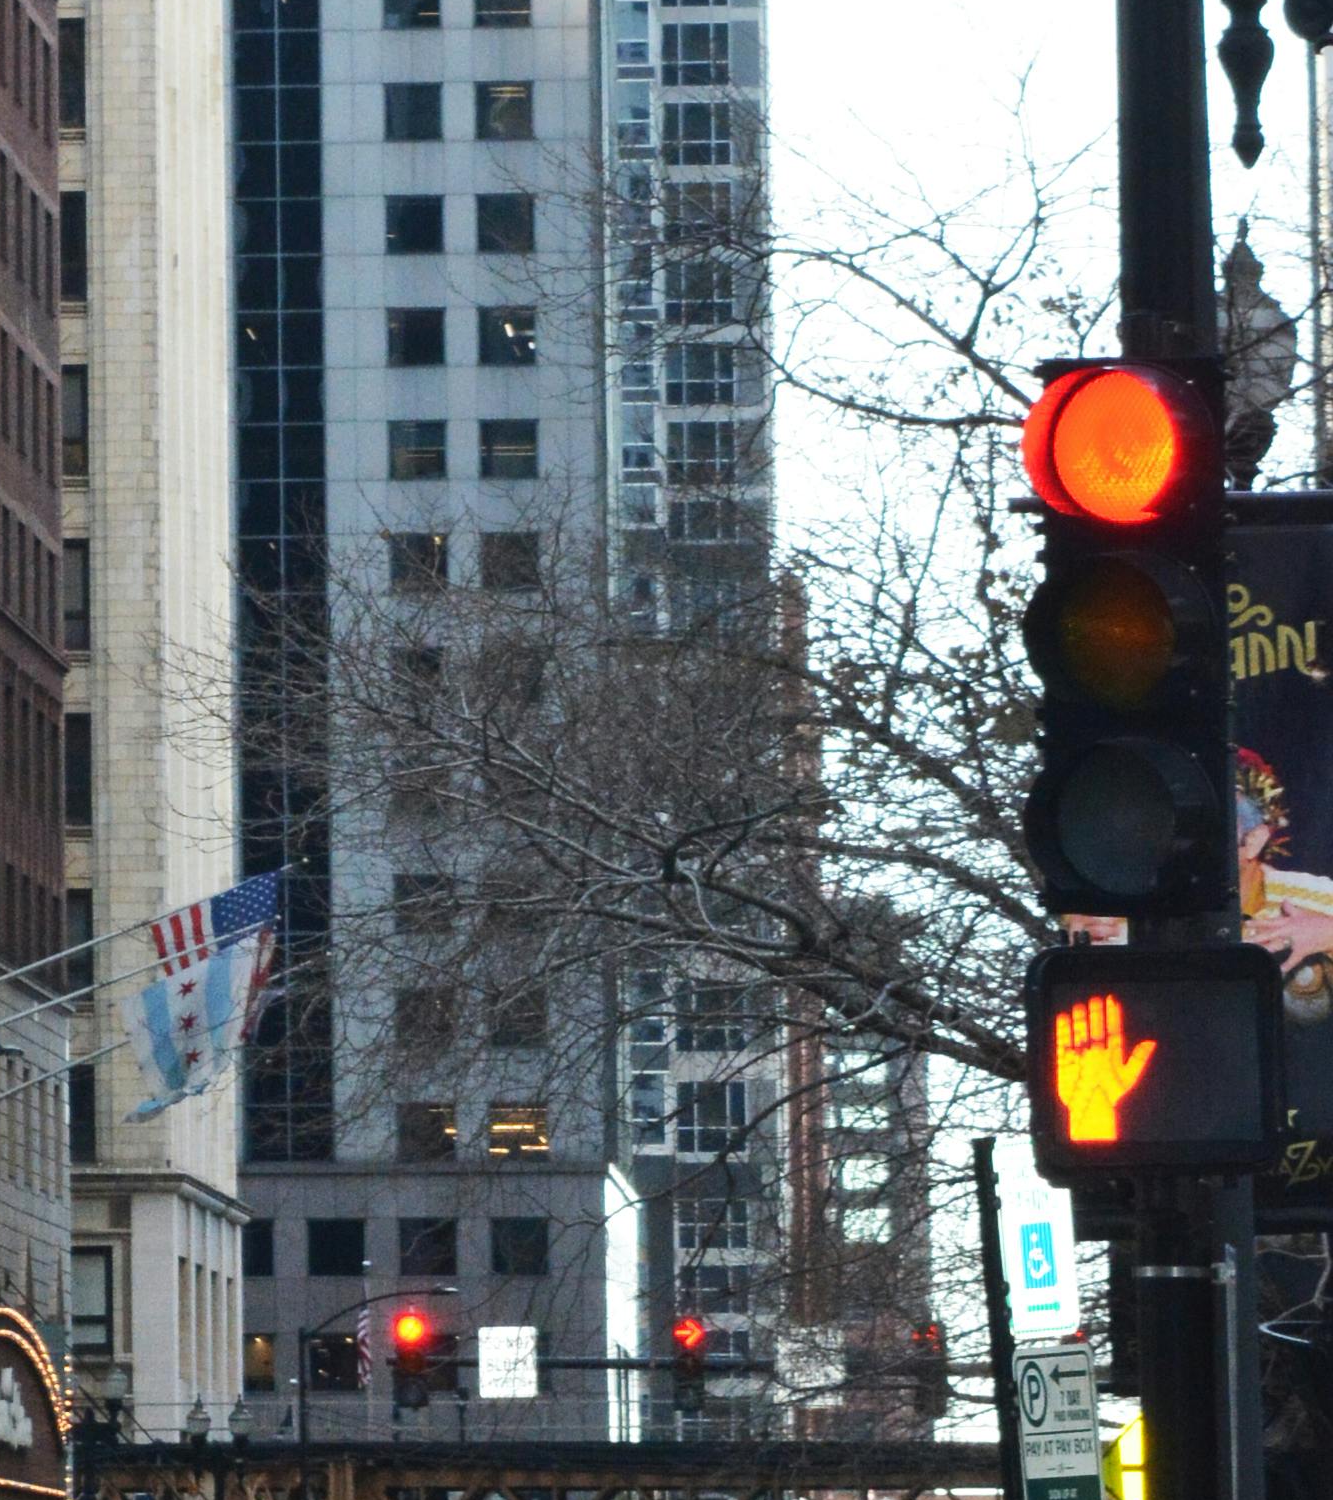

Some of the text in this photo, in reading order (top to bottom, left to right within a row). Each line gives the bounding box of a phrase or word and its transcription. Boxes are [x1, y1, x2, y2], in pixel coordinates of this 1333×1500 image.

[1025, 1438, 1093, 1457] PAY AT PAY BOX
